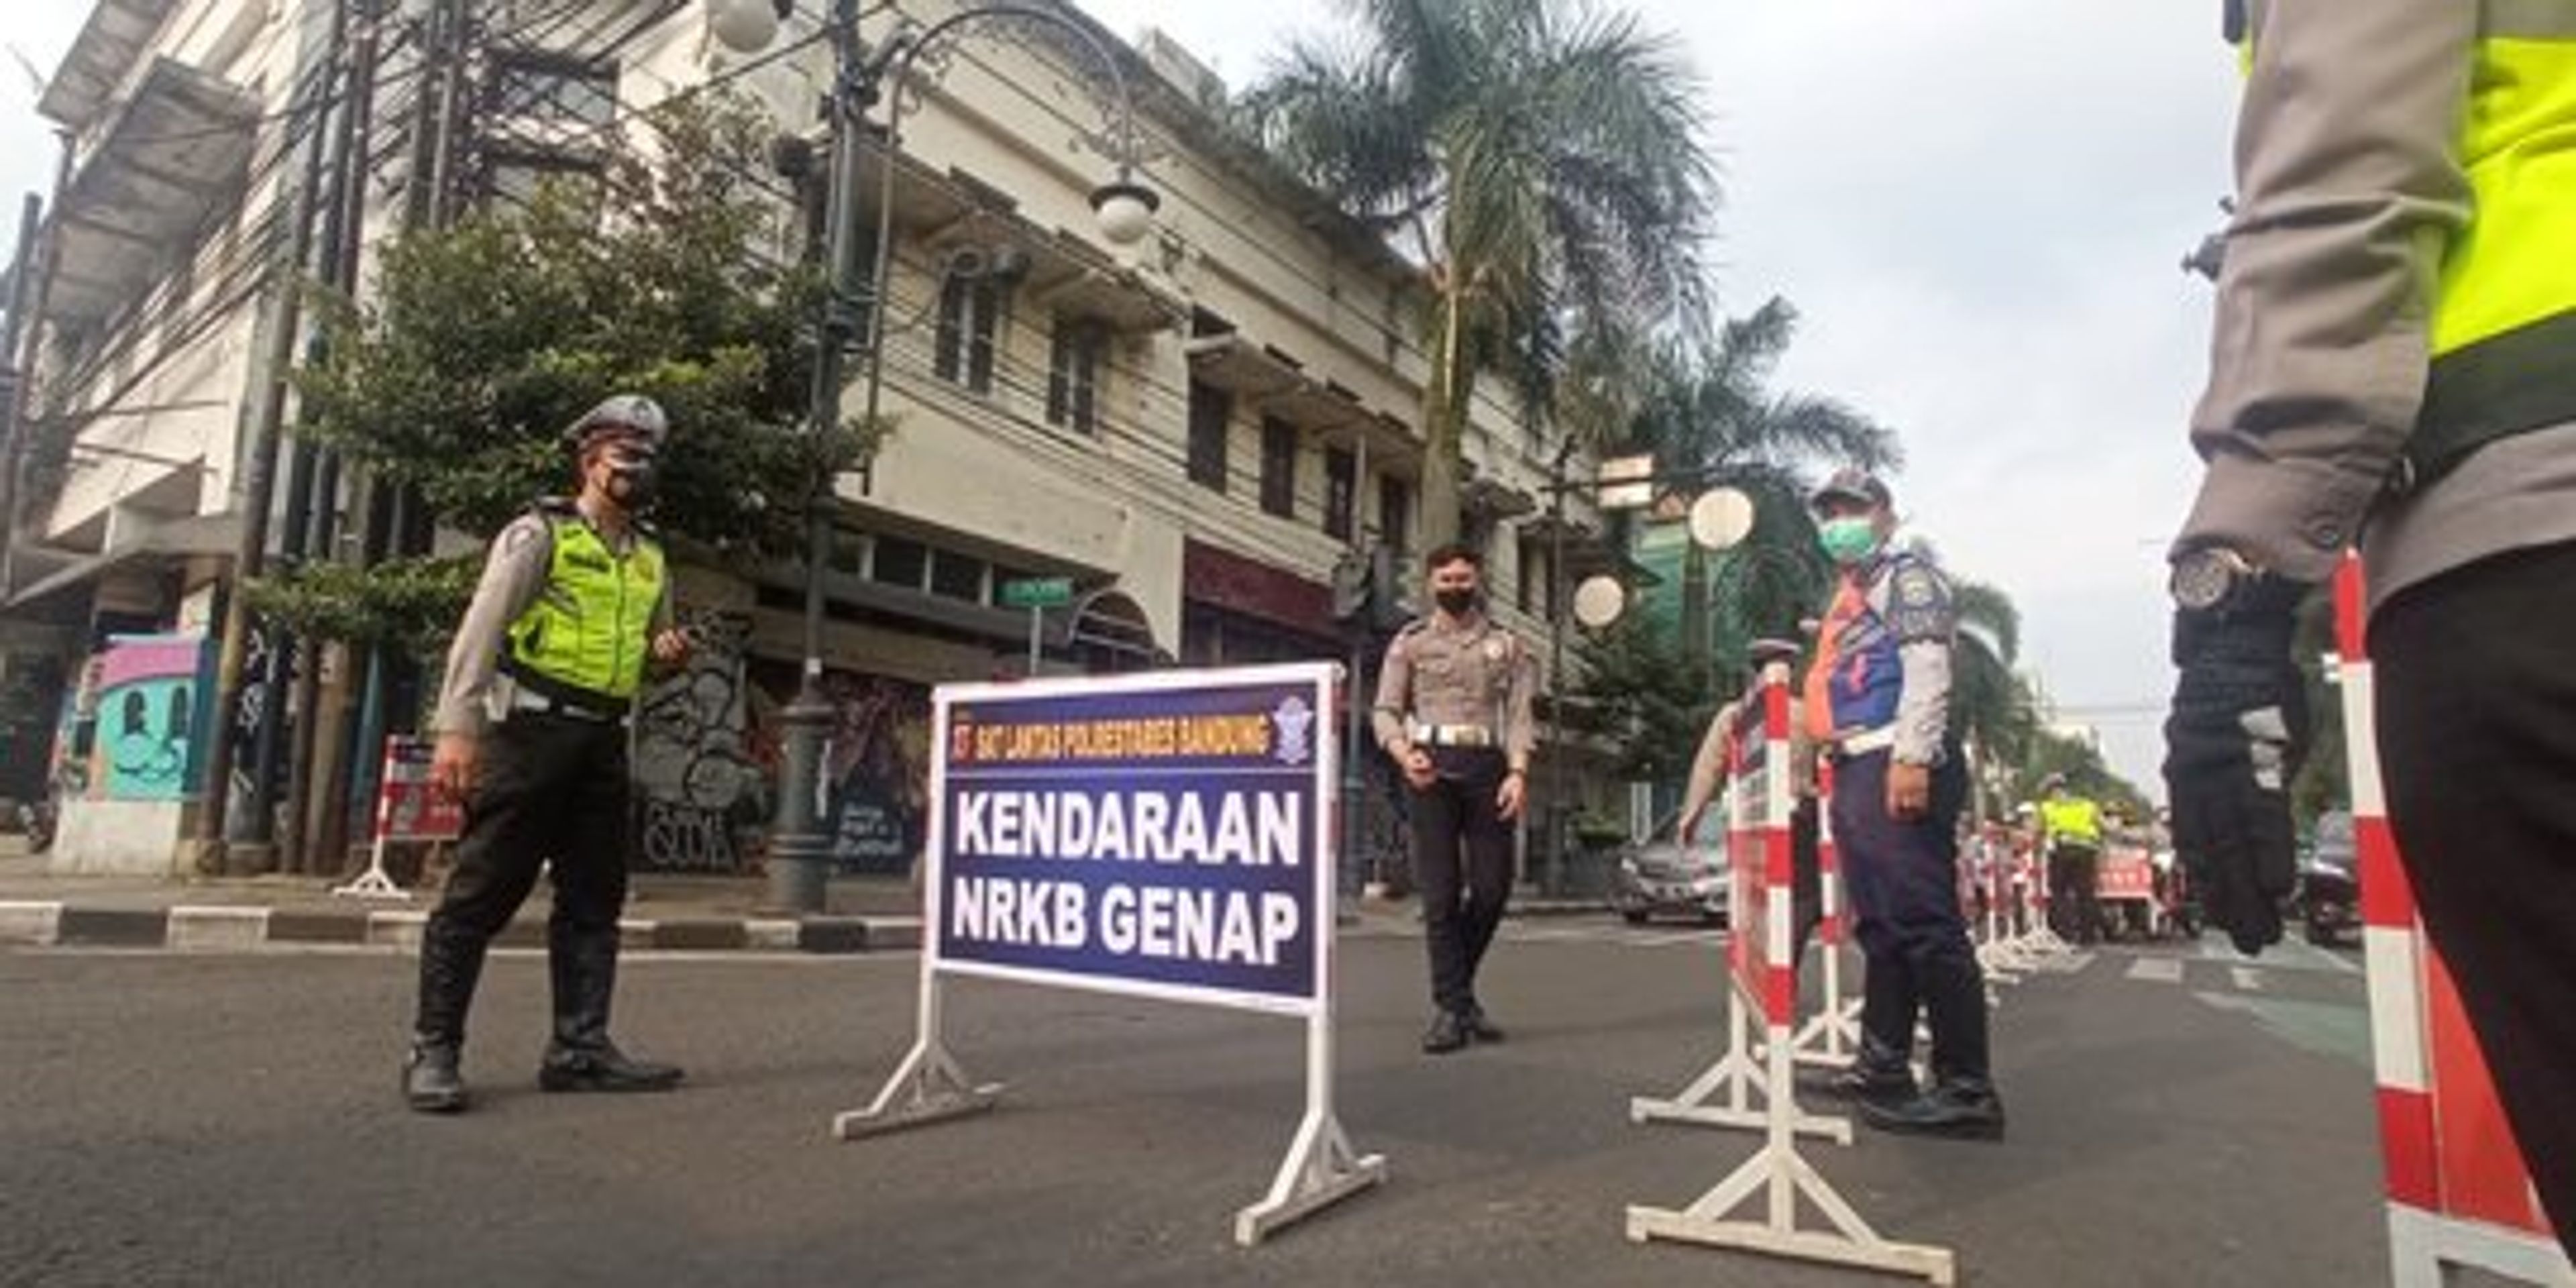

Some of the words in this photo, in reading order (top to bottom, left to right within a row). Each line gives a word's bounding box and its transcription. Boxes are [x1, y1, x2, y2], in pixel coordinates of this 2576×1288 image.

[1007, 722, 1061, 759] LANTAS
[1179, 712, 1269, 755] BANDUNG
[957, 791, 1300, 865] KENDARAAN
[953, 877, 1087, 947] NRKB
[1100, 883, 1299, 965] GENAP
